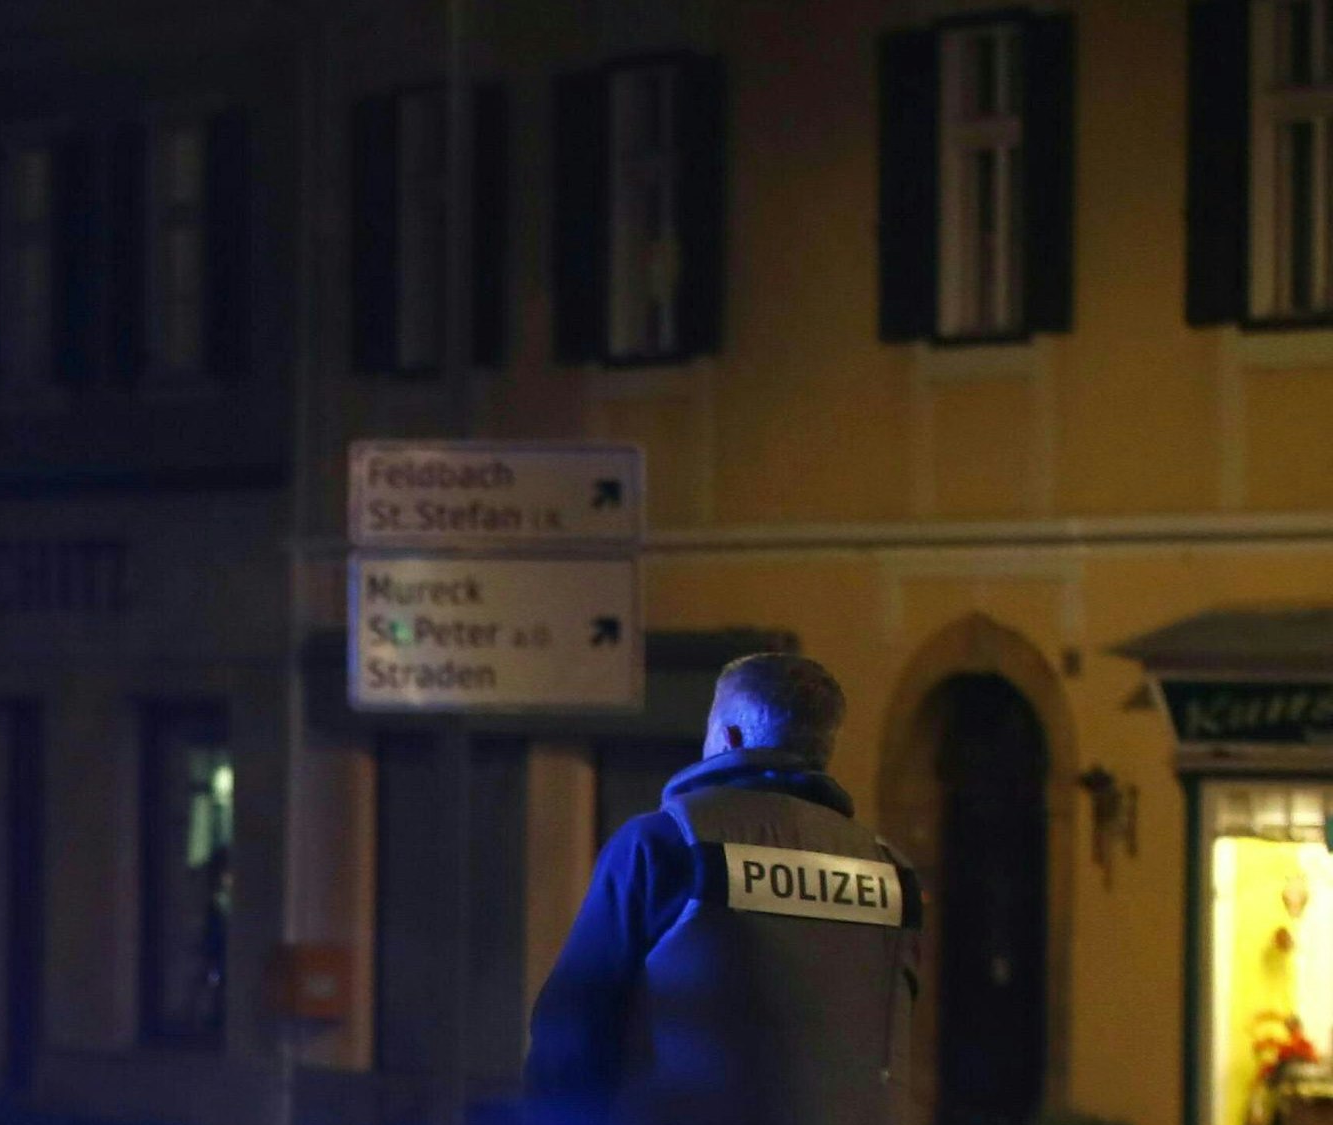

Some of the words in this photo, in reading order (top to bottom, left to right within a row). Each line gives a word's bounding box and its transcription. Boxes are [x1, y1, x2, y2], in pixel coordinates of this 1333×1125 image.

[369, 456, 515, 488] Feldbach
[367, 573, 482, 604] Mureck
[415, 616, 497, 647] Peter
[368, 658, 496, 690] Straden
[743, 861, 888, 909] POLIZEI
